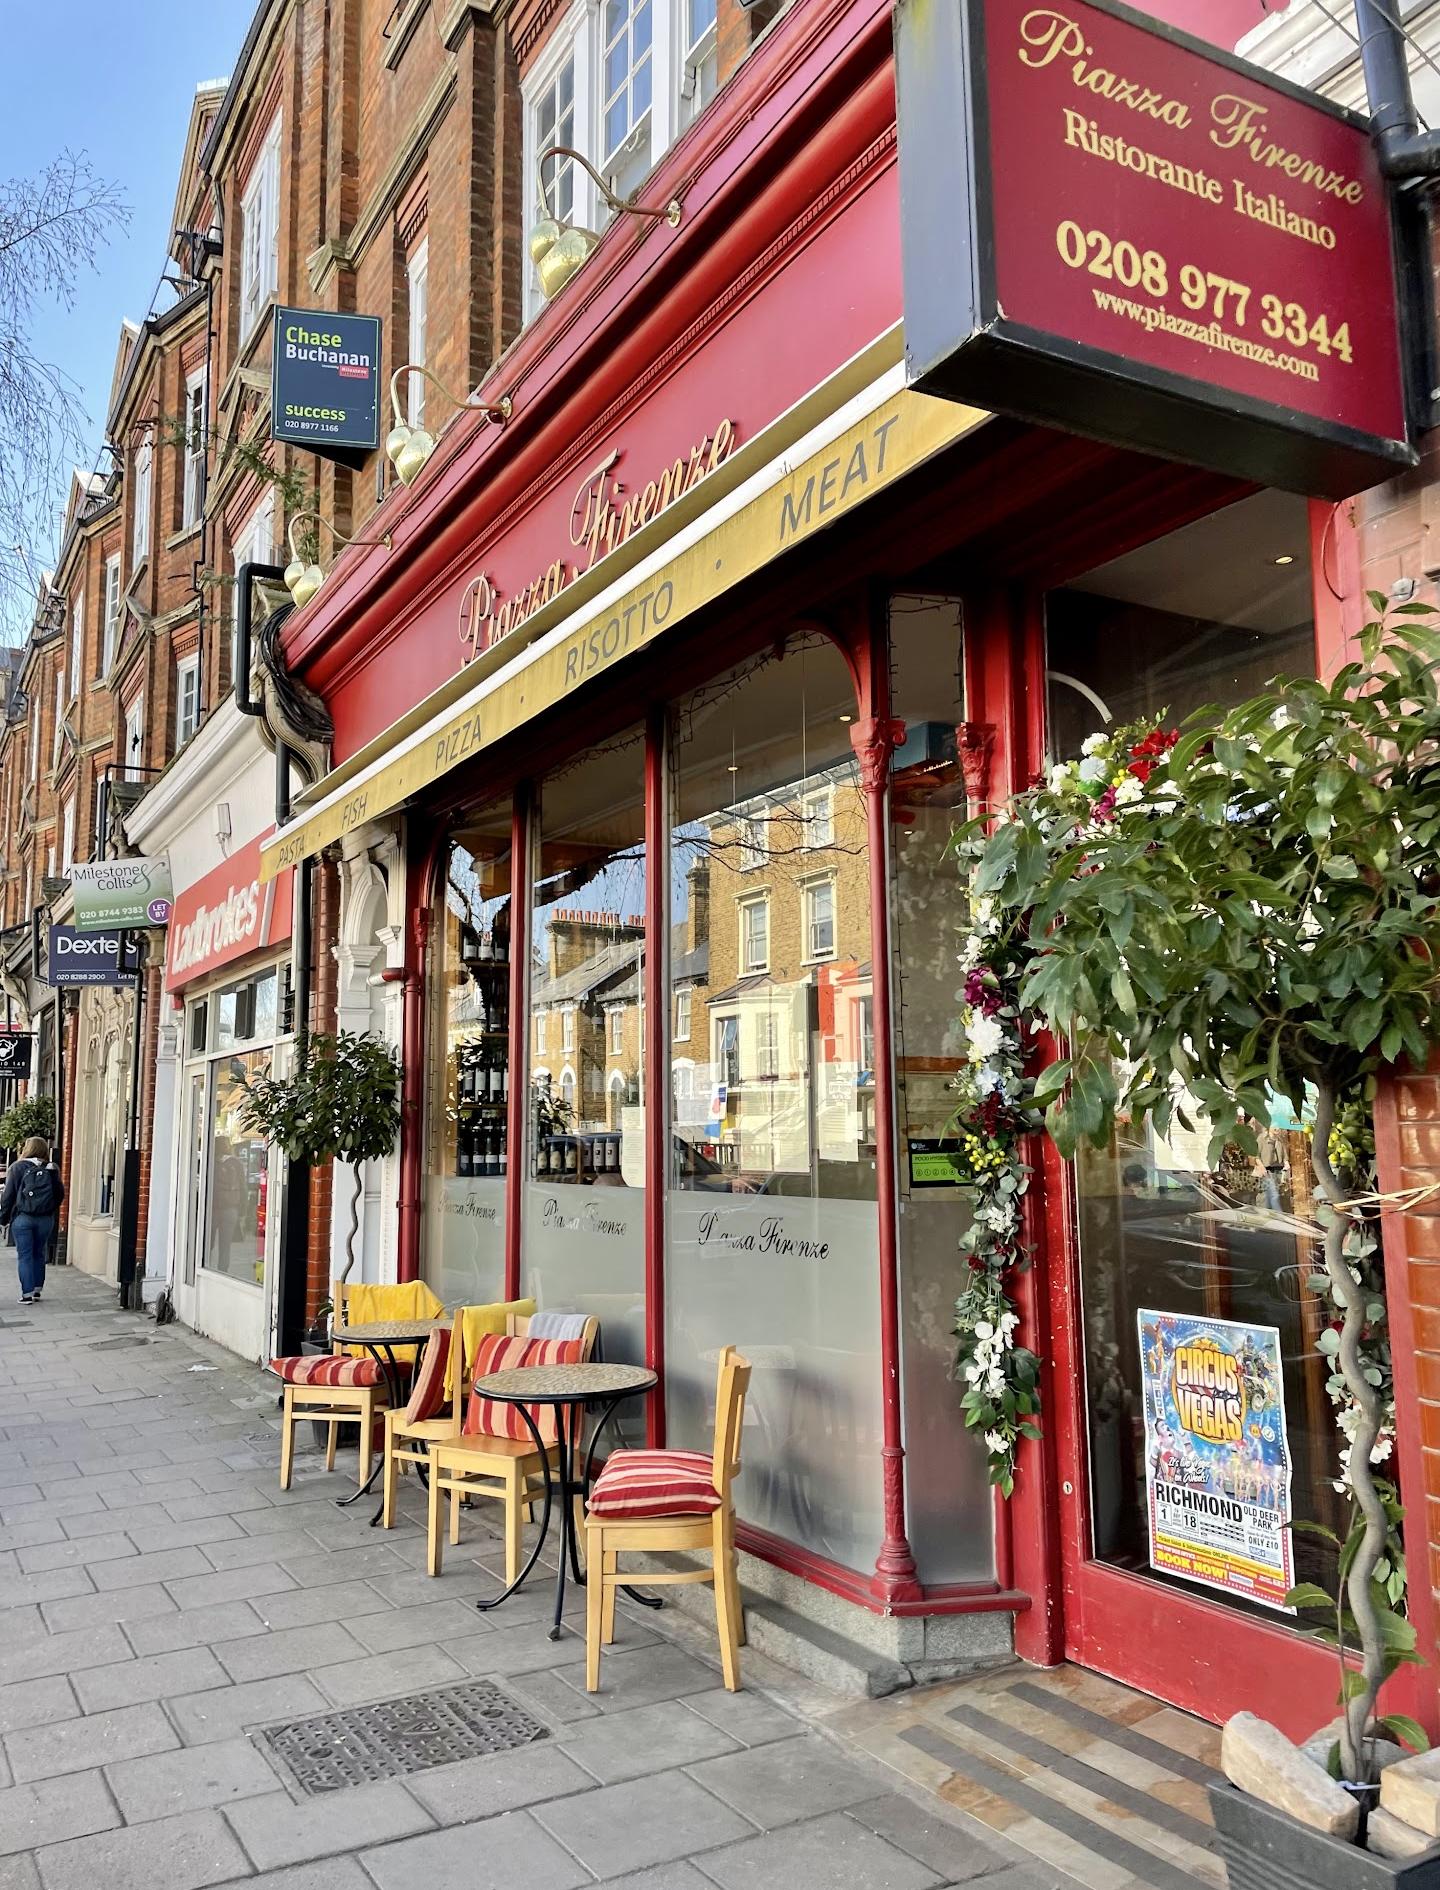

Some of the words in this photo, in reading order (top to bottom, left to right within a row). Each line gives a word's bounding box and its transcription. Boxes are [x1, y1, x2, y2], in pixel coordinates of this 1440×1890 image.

[1018, 9, 1194, 131] Piazza
[1209, 94, 1364, 205] Firenze
[1062, 108, 1224, 205] Ristorante
[1233, 179, 1337, 250] Italiano
[1056, 220, 1169, 298] 0208
[1180, 264, 1250, 327] 977
[1261, 293, 1354, 364] 3344
[286, 326, 342, 348] Chase
[1092, 287, 1319, 382] www.piazzafirenze.com
[286, 343, 370, 367] Buchanan
[285, 404, 346, 421] success
[285, 420, 300, 429] 020
[300, 421, 319, 431] 8977
[320, 423, 339, 433] 1166
[568, 418, 736, 575] Firenze
[276, 835, 306, 869] PASTA
[342, 792, 368, 829] FISH
[435, 714, 482, 770] PIZZA
[564, 580, 674, 686] RISOTTO
[779, 414, 900, 541] MEAT
[74, 865, 140, 881] Milestone
[97, 877, 133, 891] Collis
[80, 910, 97, 919] 020
[121, 905, 144, 915] 9383
[152, 903, 167, 911] LET
[154, 910, 166, 918] BY
[172, 880, 260, 976] Ladbrokes
[57, 936, 137, 955] Dextes
[699, 1212, 756, 1251] Pazza
[759, 1217, 830, 1260] Firenze
[1175, 1347, 1239, 1396] CIRCUS
[1176, 1387, 1243, 1441] VEGAS
[1155, 1482, 1243, 1523] RICHMOND
[1161, 1508, 1166, 1520] 1
[1183, 1514, 1197, 1528] 18
[1243, 1506, 1257, 1517] OLD
[1259, 1510, 1279, 1524] DEER
[1252, 1517, 1273, 1531] PARK
[1248, 1536, 1264, 1547] ONLY
[1266, 1540, 1279, 1550] £10
[1156, 1550, 1191, 1570] BOOK
[1194, 1560, 1228, 1581] NOW!
